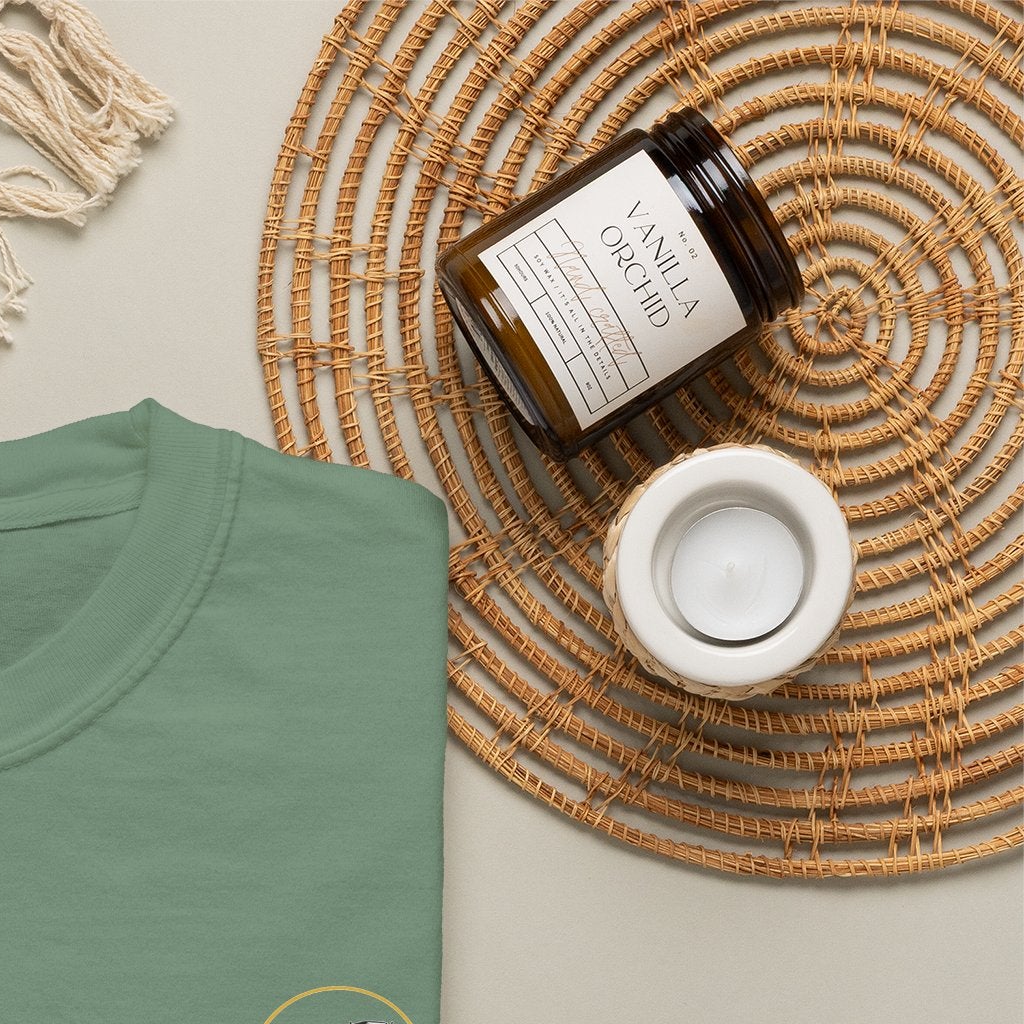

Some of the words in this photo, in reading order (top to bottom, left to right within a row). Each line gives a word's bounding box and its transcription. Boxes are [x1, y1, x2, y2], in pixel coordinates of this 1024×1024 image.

[600, 225, 670, 328] ORCHID
[627, 200, 700, 318] VANILLA
[678, 231, 688, 247] No.
[688, 247, 698, 260] 02
[533, 254, 544, 267] SOY
[543, 269, 554, 284] WAX
[558, 291, 569, 306] IT'S
[568, 309, 579, 323] ALL
[577, 324, 586, 334] IN
[585, 335, 595, 350] THE
[593, 351, 611, 380] DETAILS
[553, 324, 567, 345] NATURAL
